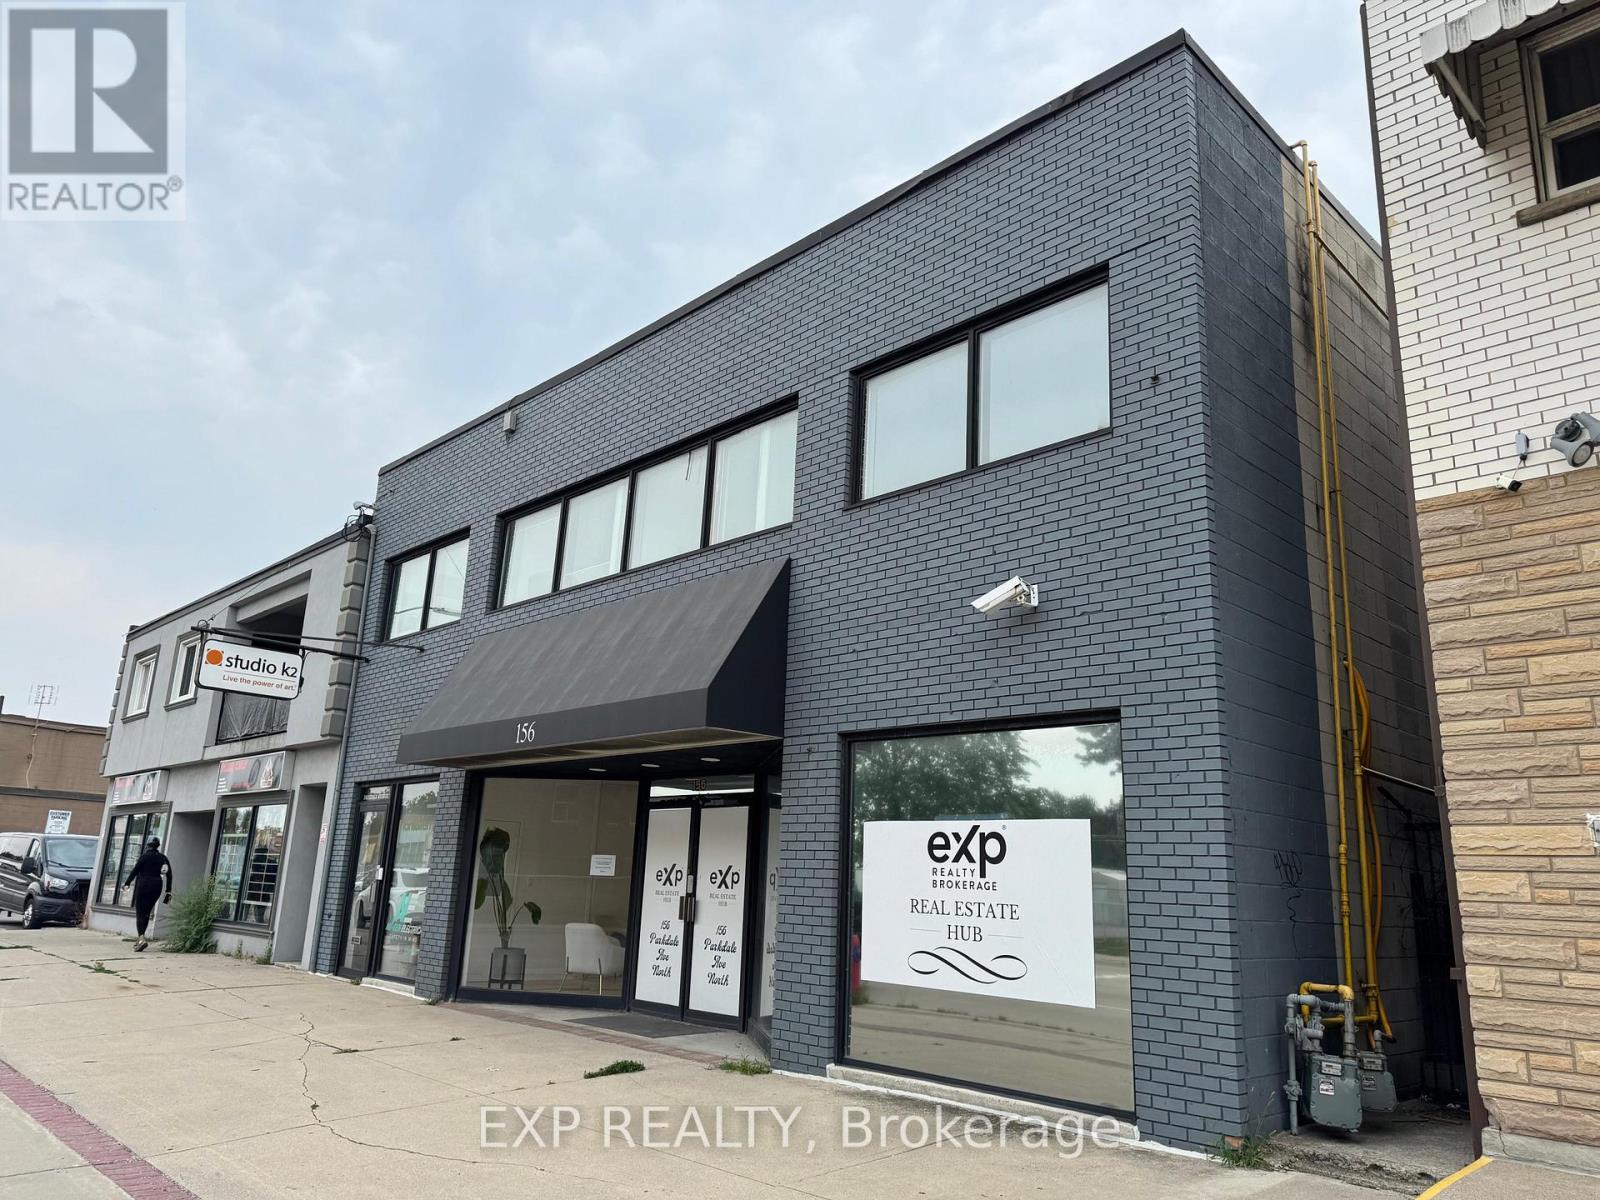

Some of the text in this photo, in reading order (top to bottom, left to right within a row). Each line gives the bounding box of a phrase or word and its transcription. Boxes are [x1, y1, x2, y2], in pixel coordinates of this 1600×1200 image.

[225, 654, 298, 678] studio k2
[222, 674, 239, 683] Live
[240, 677, 251, 685] the
[252, 680, 274, 689] power
[516, 721, 536, 743] 156
[932, 867, 976, 878] REALTY
[932, 879, 997, 891] BROKERAGE
[910, 898, 1020, 920] REAL ESTATE
[660, 920, 671, 930] 156
[715, 925, 727, 936] 156
[649, 932, 680, 947] Parkdale
[946, 924, 983, 943] HUB
[703, 938, 737, 954] Parkdale
[656, 948, 670, 961] Ave
[711, 955, 727, 969] Ave
[651, 964, 672, 978] North
[707, 972, 729, 987] North
